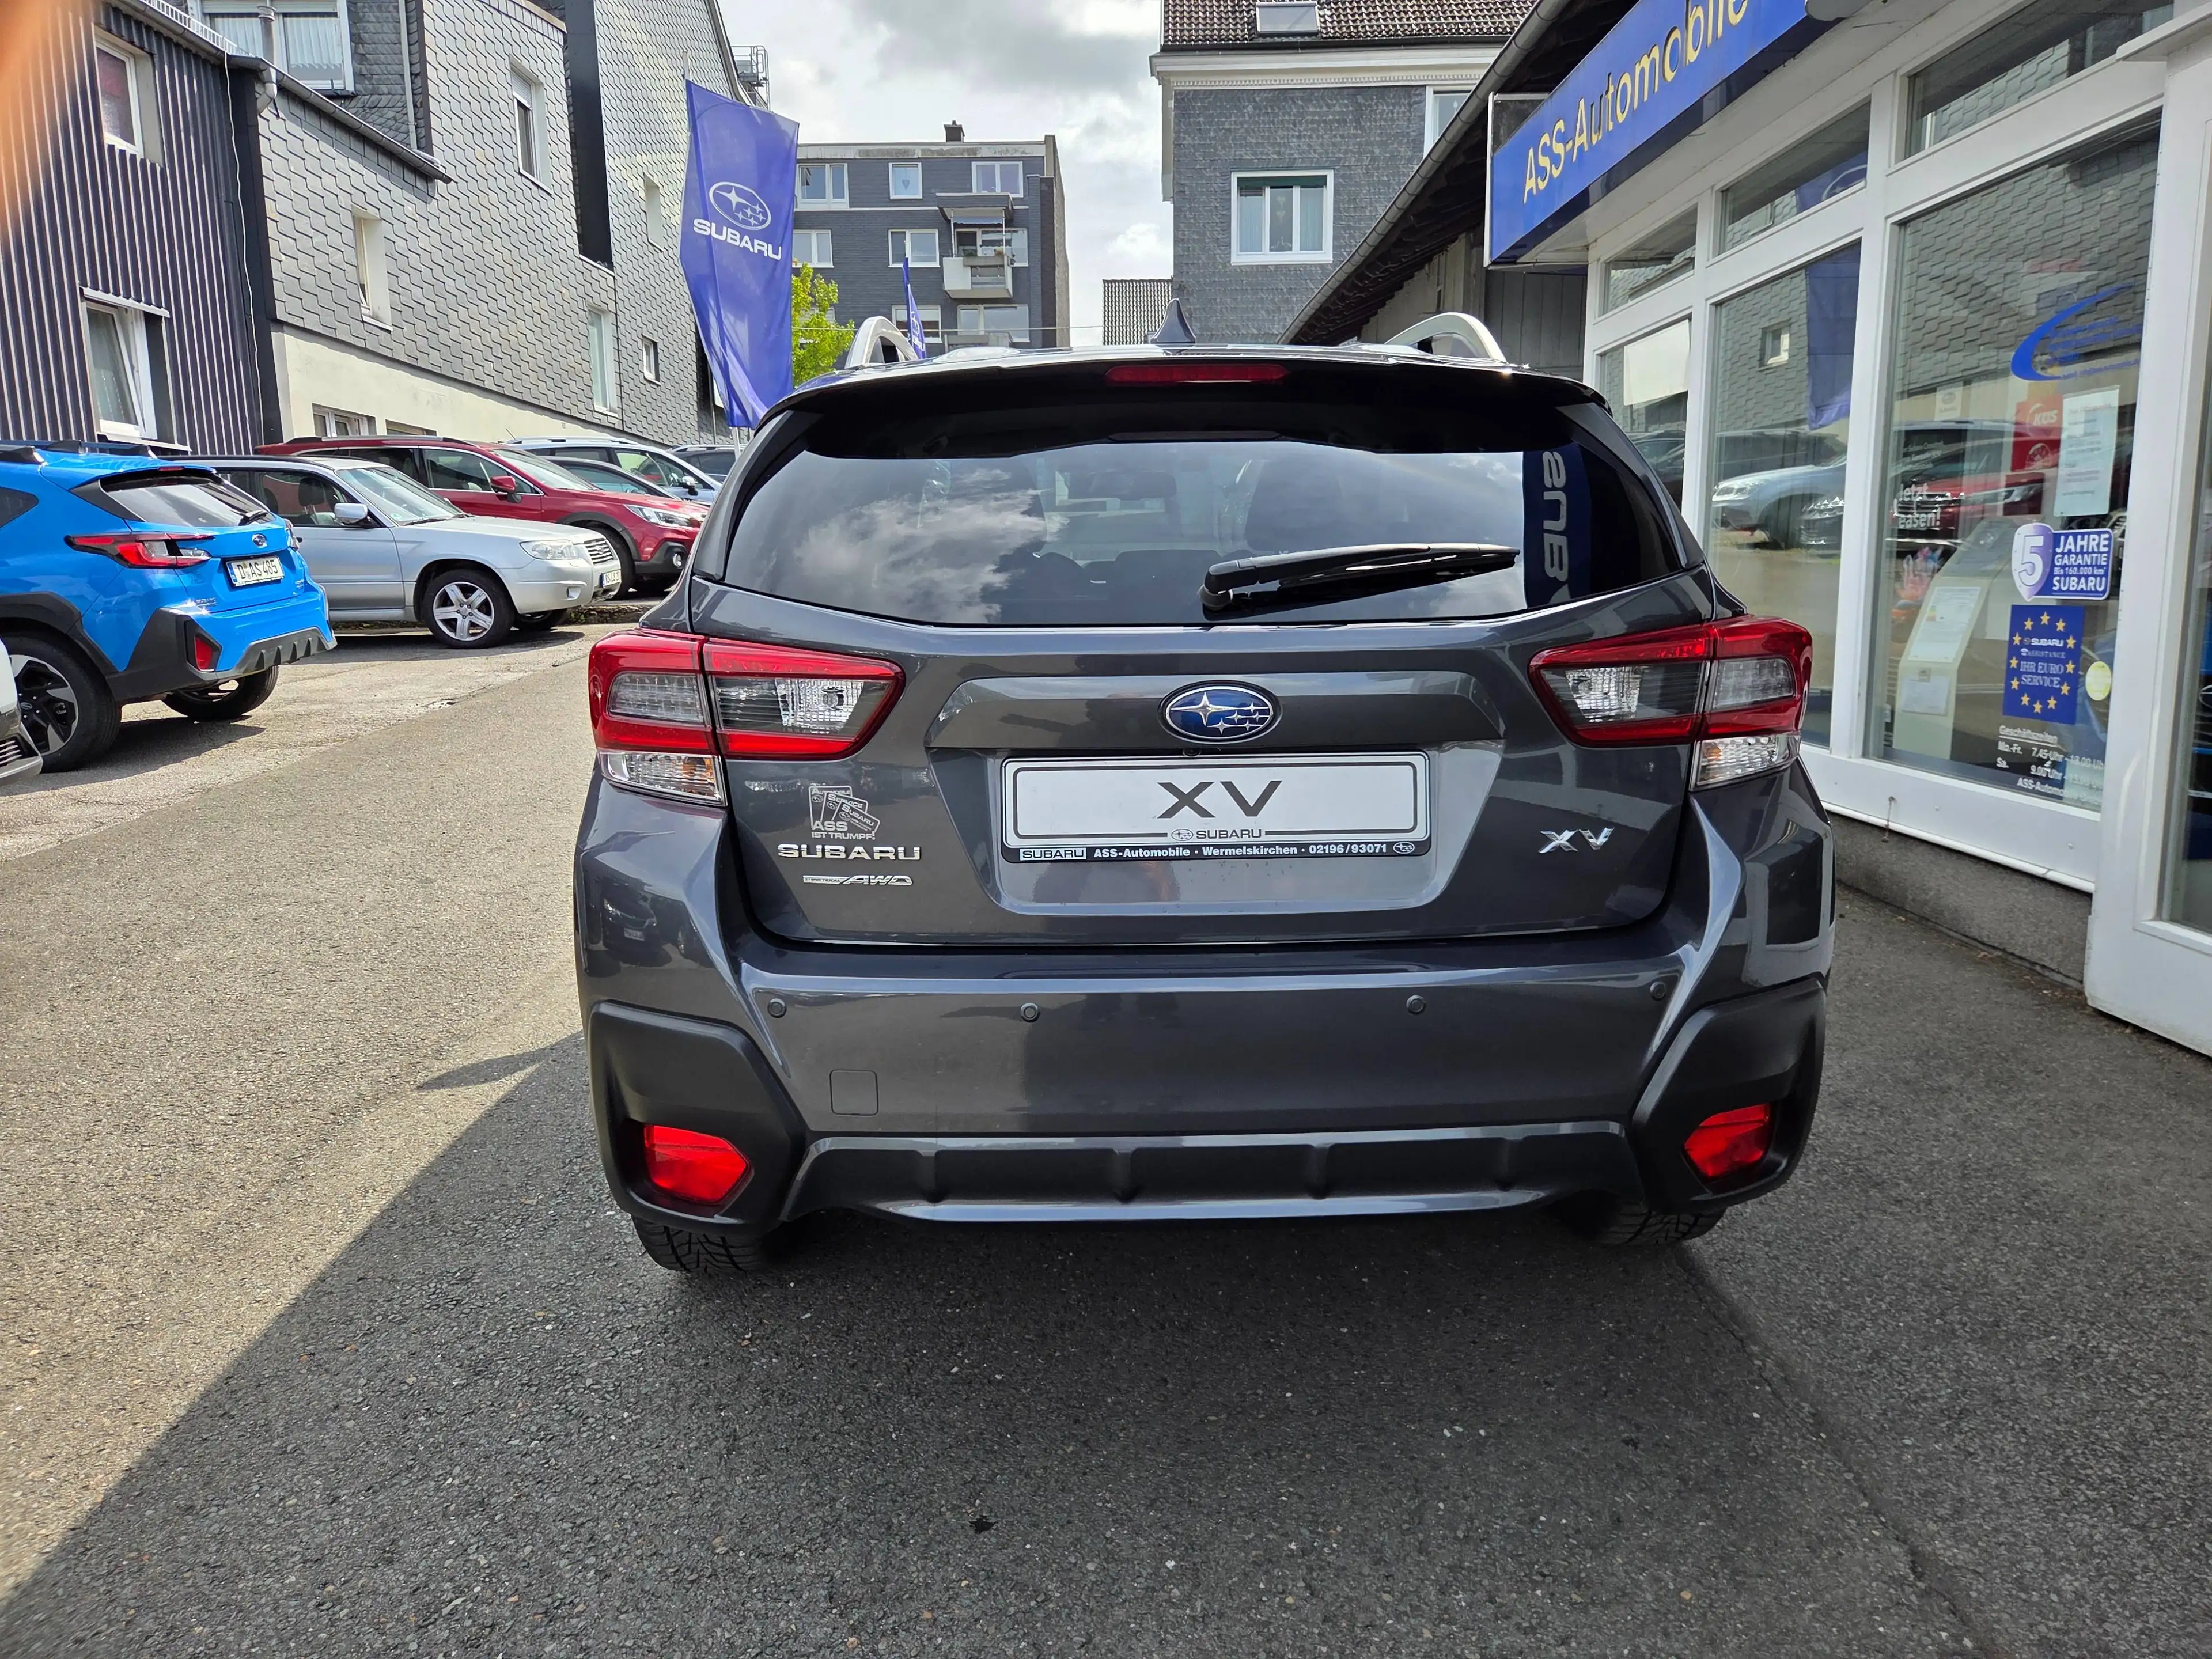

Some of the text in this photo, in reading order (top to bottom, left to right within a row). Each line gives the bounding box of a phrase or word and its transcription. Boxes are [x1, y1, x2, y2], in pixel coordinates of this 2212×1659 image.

[694, 218, 782, 260] SUBARU
[2018, 533, 2109, 586] 5 JAHRE
[2054, 554, 2108, 566] GARANTIE
[237, 560, 278, 579] D AS 485
[2052, 576, 2105, 592] SUBARU
[2031, 638, 2064, 647] SUBARU
[2028, 650, 2066, 658] ASSISTANCE
[2020, 661, 2065, 675] IHR EURO
[2021, 675, 2061, 688] SERVICE
[1157, 781, 1283, 819] XV
[812, 820, 848, 831] ASS
[828, 831, 876, 840] TRUMPF!
[1196, 830, 1262, 839] SUBARU
[1538, 827, 1615, 854] XV
[778, 843, 921, 860] SUBARU
[1022, 844, 1387, 859] SUBARU ASS-Automobile Wermelskirchen 02196/93071
[843, 874, 912, 885] AWD
